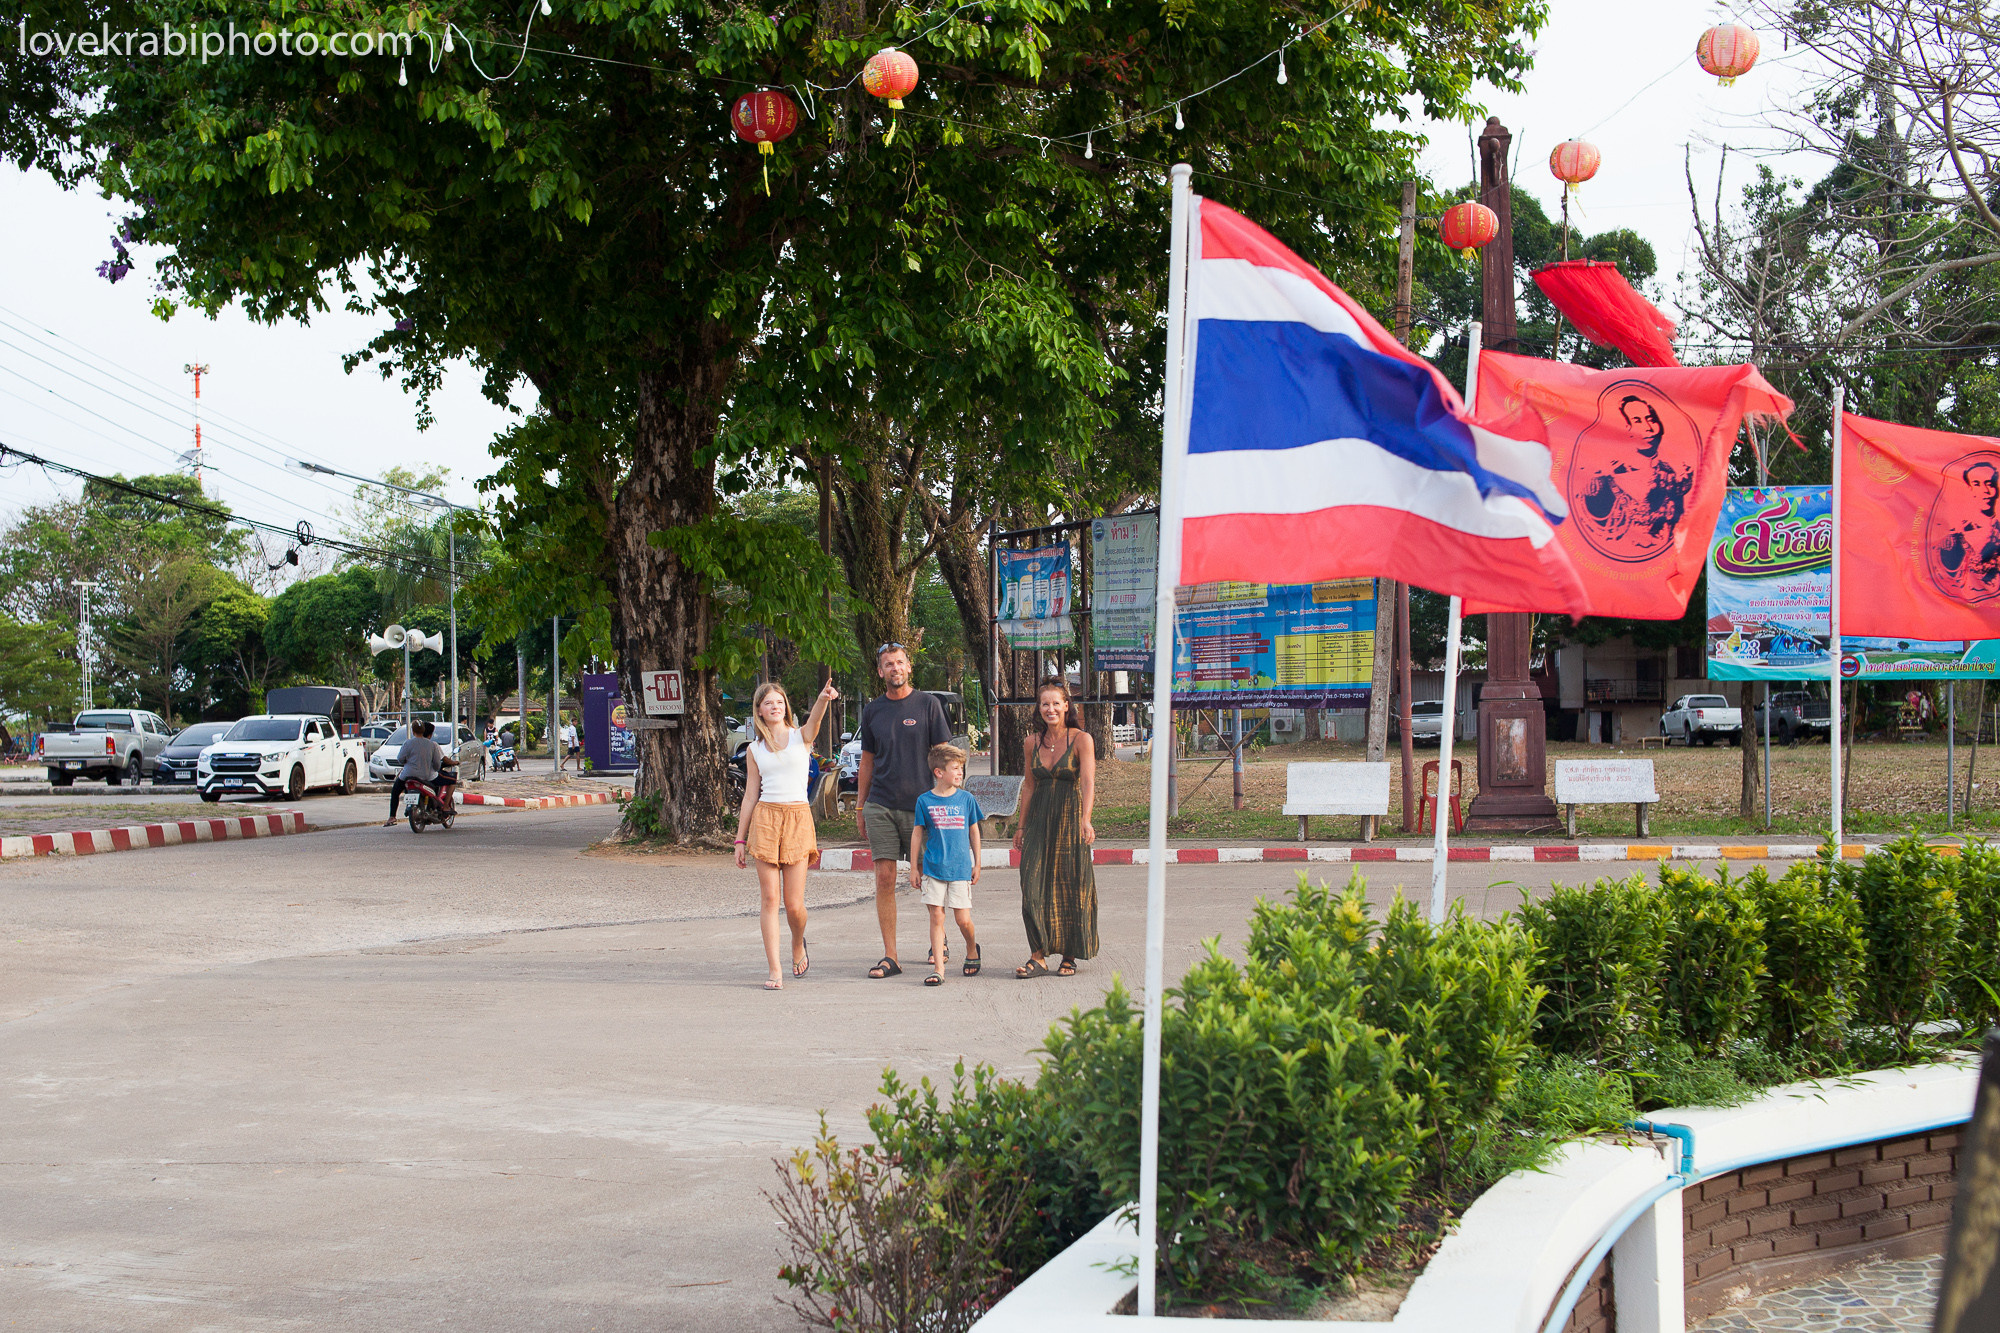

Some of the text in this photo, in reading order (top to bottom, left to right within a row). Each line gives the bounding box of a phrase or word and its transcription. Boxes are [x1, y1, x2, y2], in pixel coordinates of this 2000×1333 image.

[1111, 521, 1129, 540] ห้าม
[1111, 594, 1136, 603] NO LITTER
